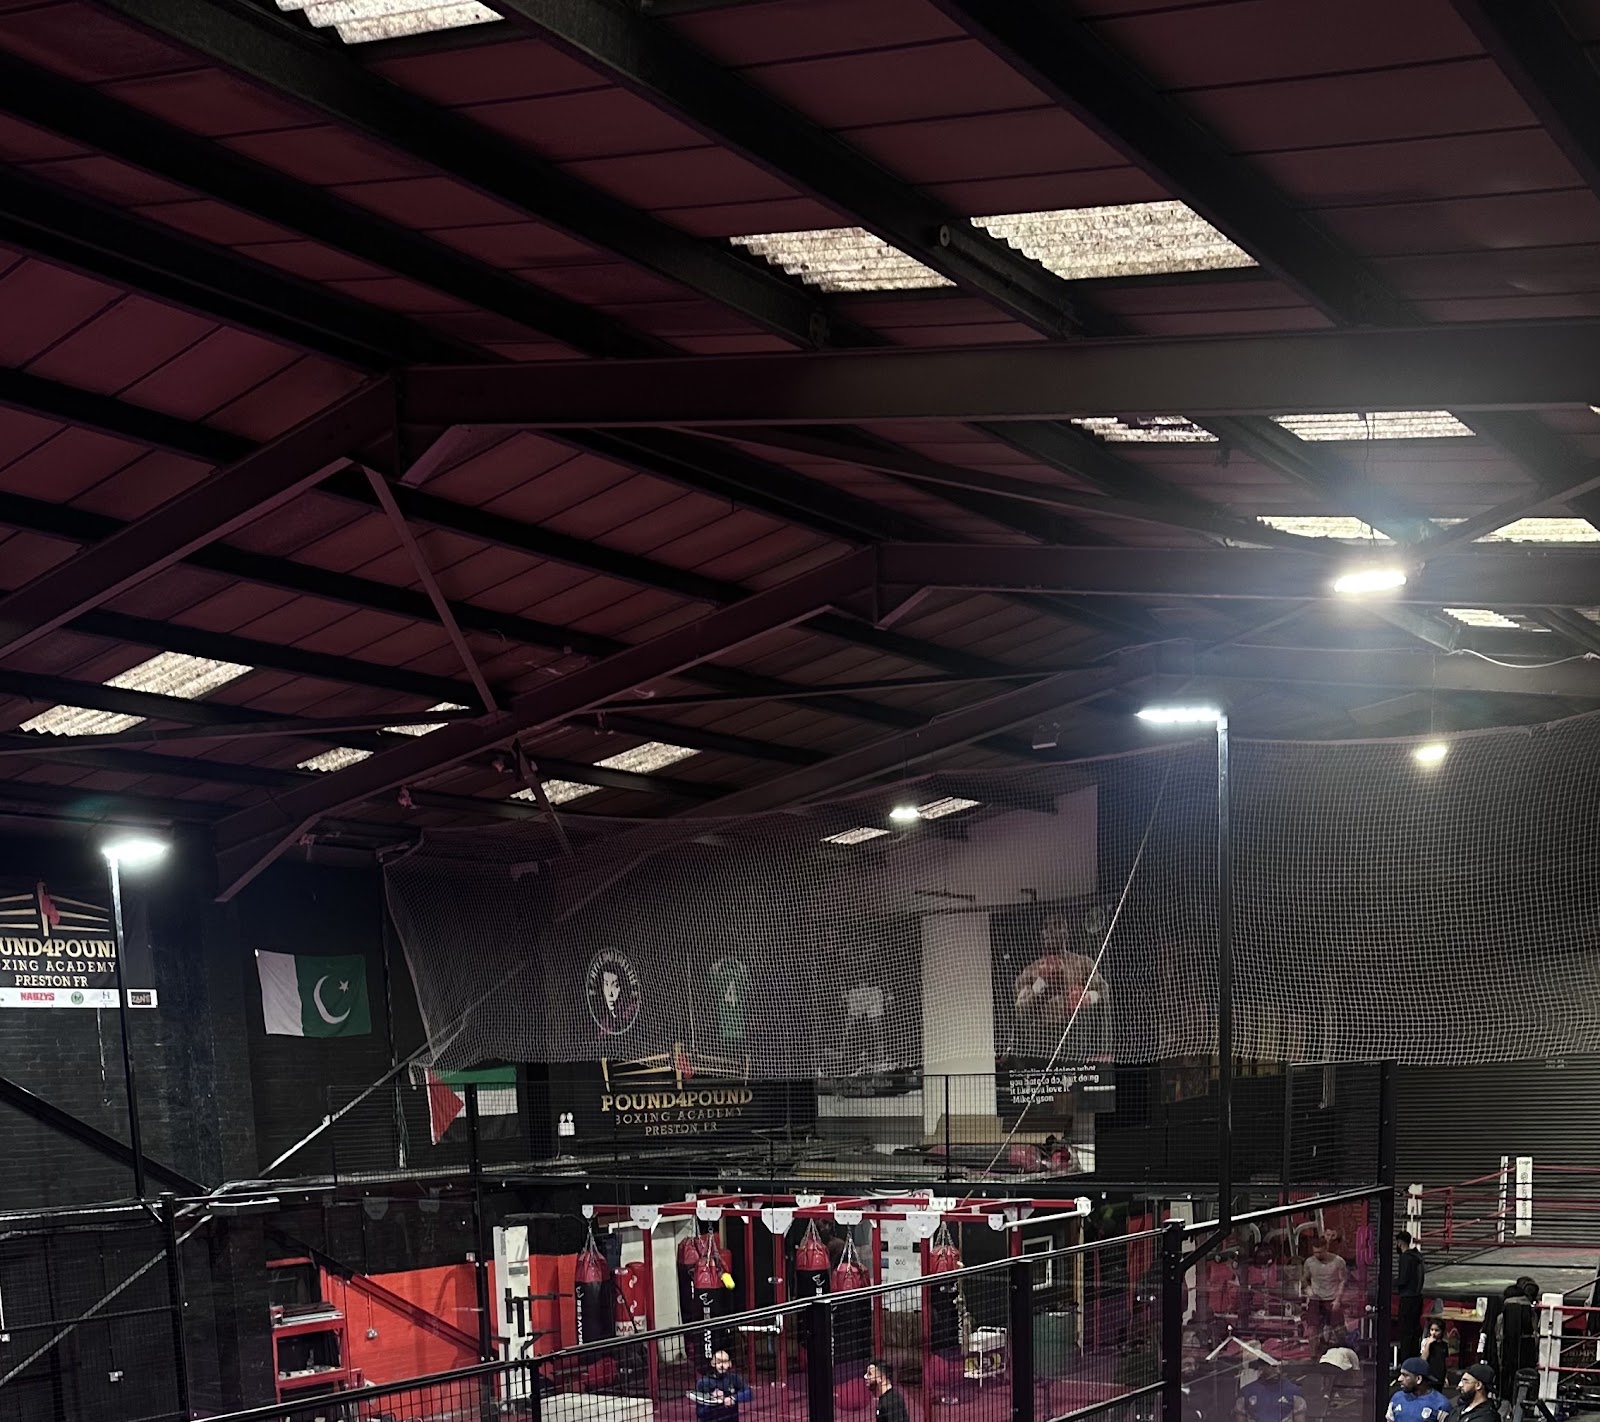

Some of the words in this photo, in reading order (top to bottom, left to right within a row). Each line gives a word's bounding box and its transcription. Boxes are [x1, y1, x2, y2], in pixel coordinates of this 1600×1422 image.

[46, 960, 115, 972] ACADEMY
[15, 974, 71, 987] PRESTON
[73, 976, 89, 987] FR
[601, 1089, 753, 1112] POUND4POUND
[677, 1107, 744, 1121] ACADEMY
[645, 1124, 700, 1136] PRESTON
